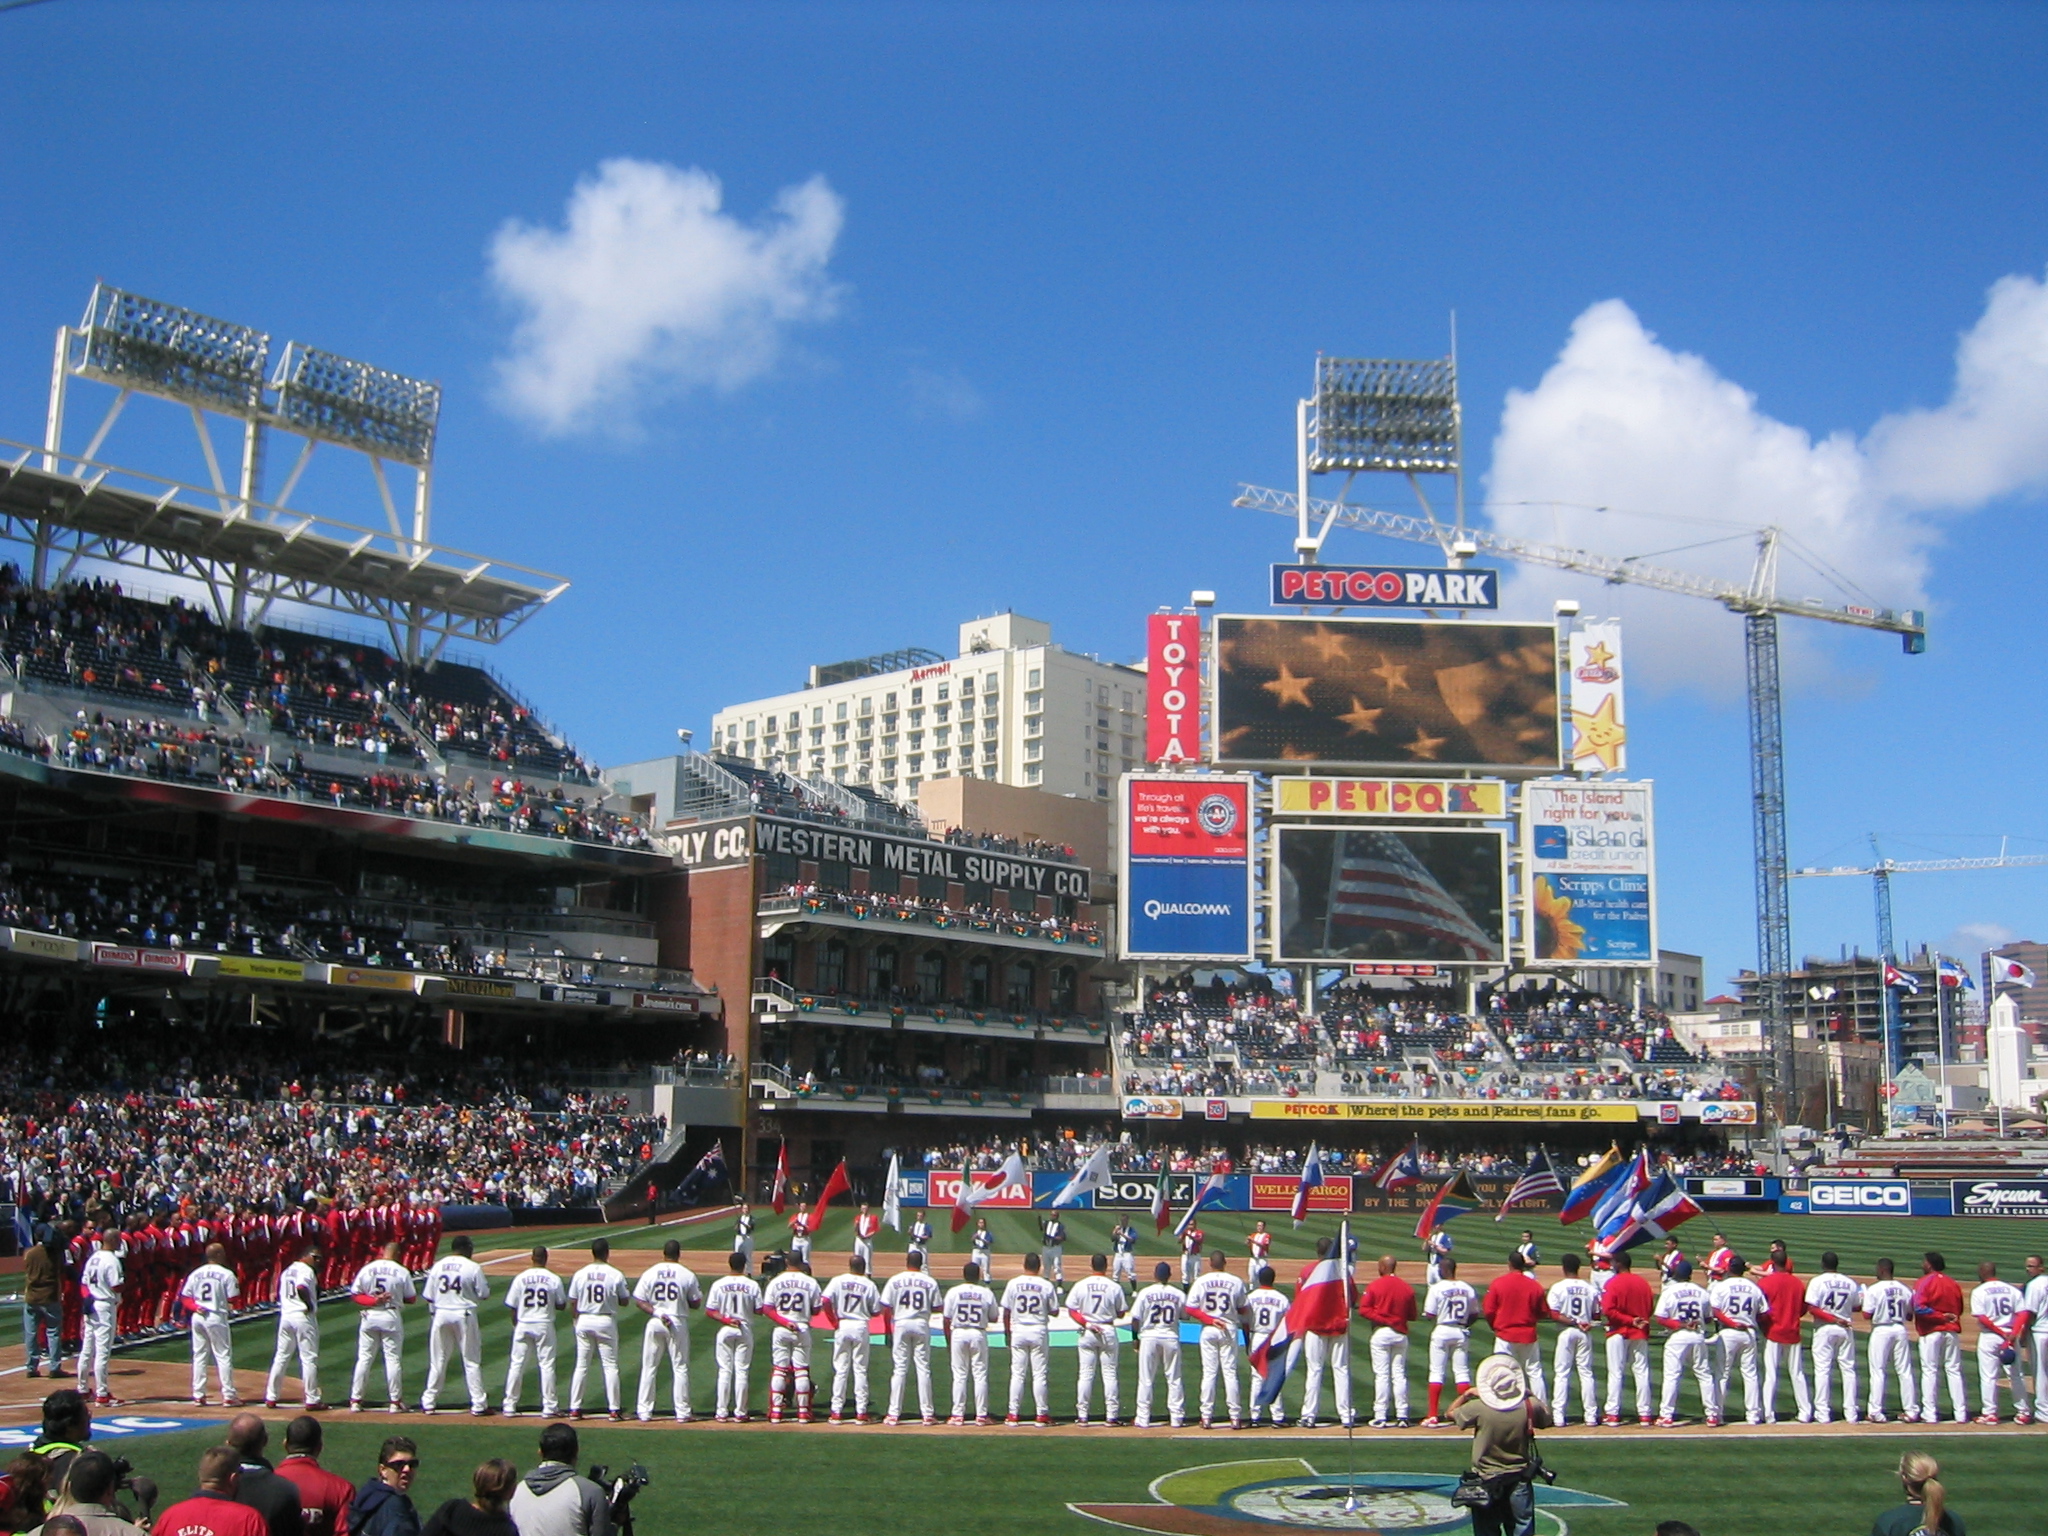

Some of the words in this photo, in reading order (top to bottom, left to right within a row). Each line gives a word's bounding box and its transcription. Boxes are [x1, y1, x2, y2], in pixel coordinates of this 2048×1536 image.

[1282, 571, 1402, 601] PETCO
[1405, 573, 1488, 604] PARK
[1163, 620, 1186, 759] TOYOTA
[1309, 781, 1442, 813] PETCO
[1554, 789, 1577, 803] The
[1582, 789, 1623, 804] Island
[1543, 805, 1575, 822] right
[1580, 804, 1599, 819] for
[1567, 826, 1646, 847] island
[756, 822, 872, 865] WESTERN
[883, 843, 958, 880] METAL
[965, 856, 1045, 891] SUPPLY
[1055, 871, 1087, 898] CO.
[1570, 850, 1605, 860] credit
[1559, 877, 1605, 895] Scripps
[1608, 877, 1647, 892] Clinic
[1144, 900, 1230, 920] QUALCOMM
[1605, 899, 1630, 908] health
[1593, 911, 1606, 920] for
[1607, 912, 1620, 920] the
[1622, 912, 1648, 920] Padres
[1284, 1104, 1329, 1115] PETCO
[1350, 1105, 1396, 1116] Where
[1402, 1105, 1424, 1116] the
[1429, 1106, 1459, 1118] pets
[1463, 1105, 1489, 1117] and
[1494, 1106, 1541, 1117] Padres
[1545, 1106, 1576, 1117] fans
[1580, 1108, 1600, 1120] go.
[1255, 1184, 1299, 1195] WELLS
[1310, 1186, 1348, 1195] ARGO
[1416, 1184, 1437, 1192] SAY
[1812, 1185, 1908, 1206] GEICO
[1964, 1183, 2048, 1208] Sycuan
[1365, 1199, 1379, 1207] BY
[1388, 1199, 1409, 1207] THE
[442, 1263, 462, 1272] ORTIZ
[201, 1283, 212, 1301] 2
[375, 1278, 387, 1294] 5
[439, 1275, 461, 1294] 34
[587, 1284, 604, 1303] 18
[654, 1282, 678, 1302] 26
[524, 1288, 548, 1308] 29
[732, 1294, 738, 1314] 1
[780, 1293, 804, 1312] 22
[843, 1293, 861, 1313] 17
[899, 1291, 924, 1310] 48
[1016, 1295, 1041, 1314] 32
[1091, 1295, 1102, 1314] 7
[1205, 1292, 1230, 1312] 53
[1571, 1297, 1582, 1316] 9
[1729, 1296, 1753, 1316] 54
[1824, 1292, 1848, 1310] 47
[1887, 1298, 1903, 1317] 51
[1992, 1298, 2011, 1316] 16
[958, 1304, 981, 1323] 55
[1150, 1305, 1175, 1324] 20
[1259, 1307, 1270, 1326] 8
[1447, 1300, 1465, 1320] 12
[1677, 1301, 1700, 1321] 56
